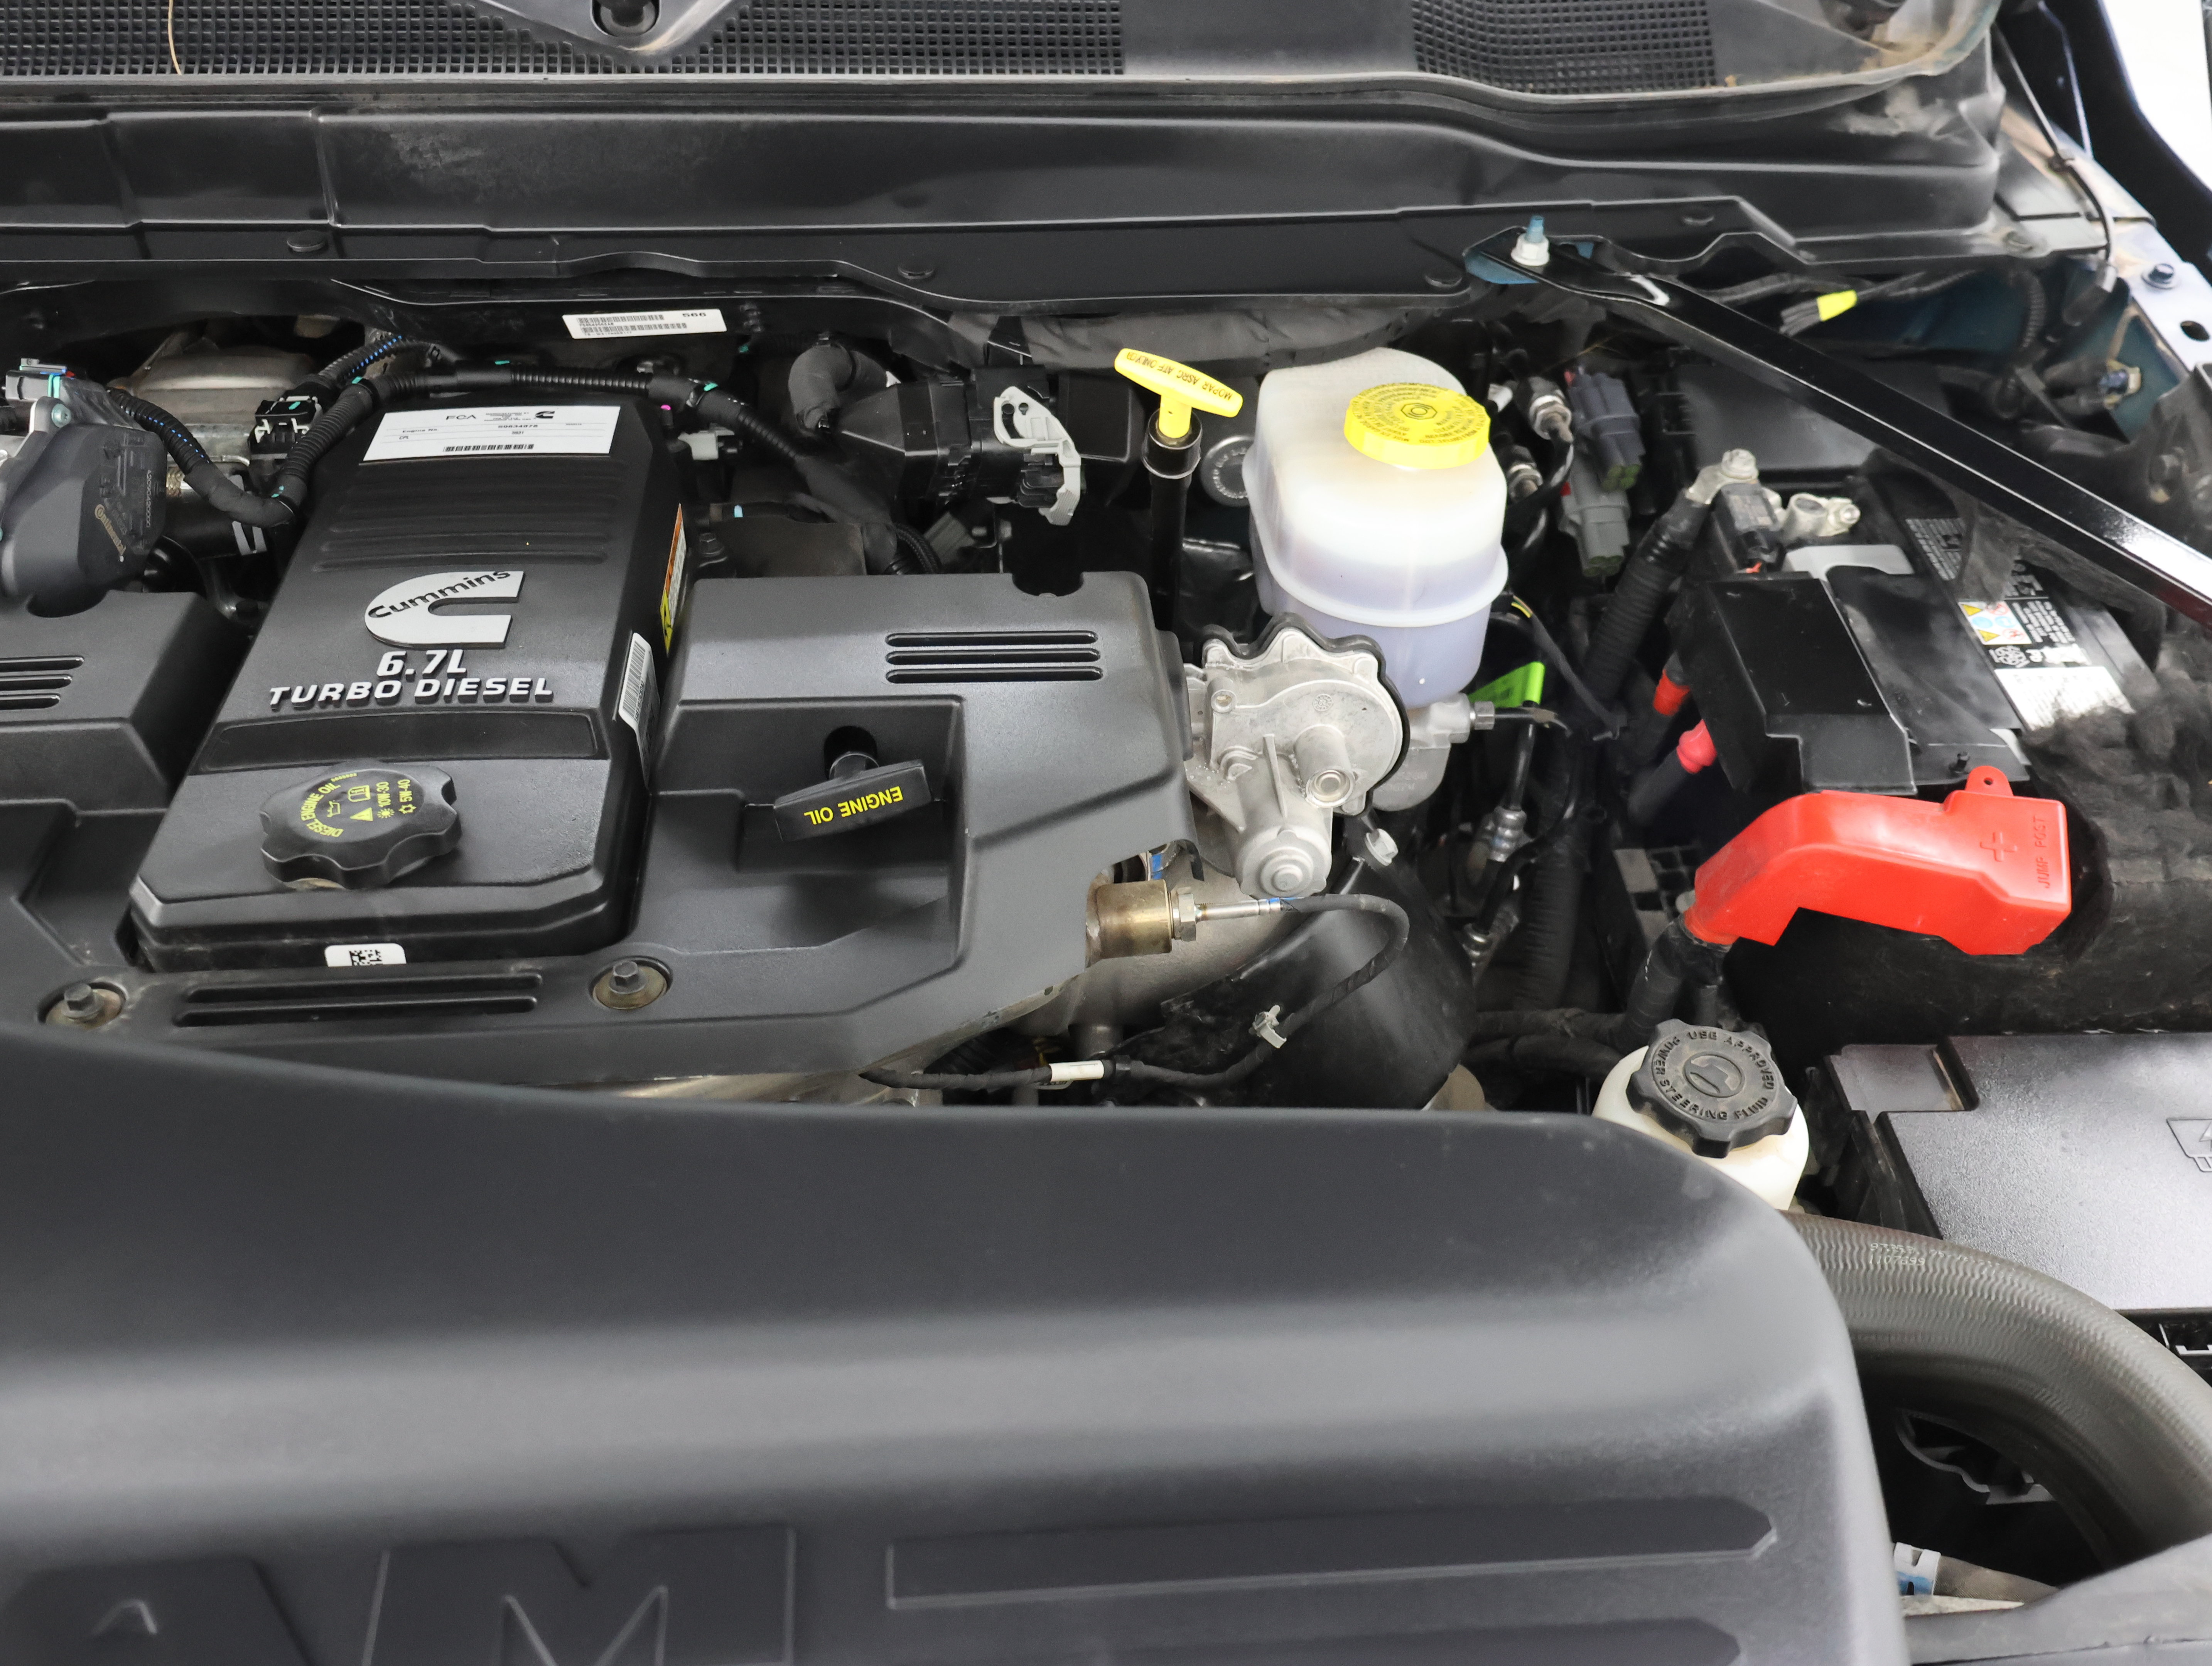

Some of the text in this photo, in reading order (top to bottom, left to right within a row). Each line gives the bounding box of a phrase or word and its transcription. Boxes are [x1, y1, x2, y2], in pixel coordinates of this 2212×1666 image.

[1135, 355, 1233, 400] MOPAR ASRC ATF ONLY
[368, 570, 512, 619] Cummins
[376, 649, 467, 679] 6.7L
[269, 676, 554, 709] TURBO DIESEL
[300, 783, 344, 838] DIESEL ENGINE OIL
[376, 781, 391, 807] 10W-30
[397, 779, 413, 803] 5W-40
[803, 785, 904, 825] ENGINE OIL
[2032, 815, 2051, 889] JUMP POST
[1653, 1036, 1769, 1120] POWER STEERING FLUID
[1687, 1030, 1776, 1091] USE APPROVED
